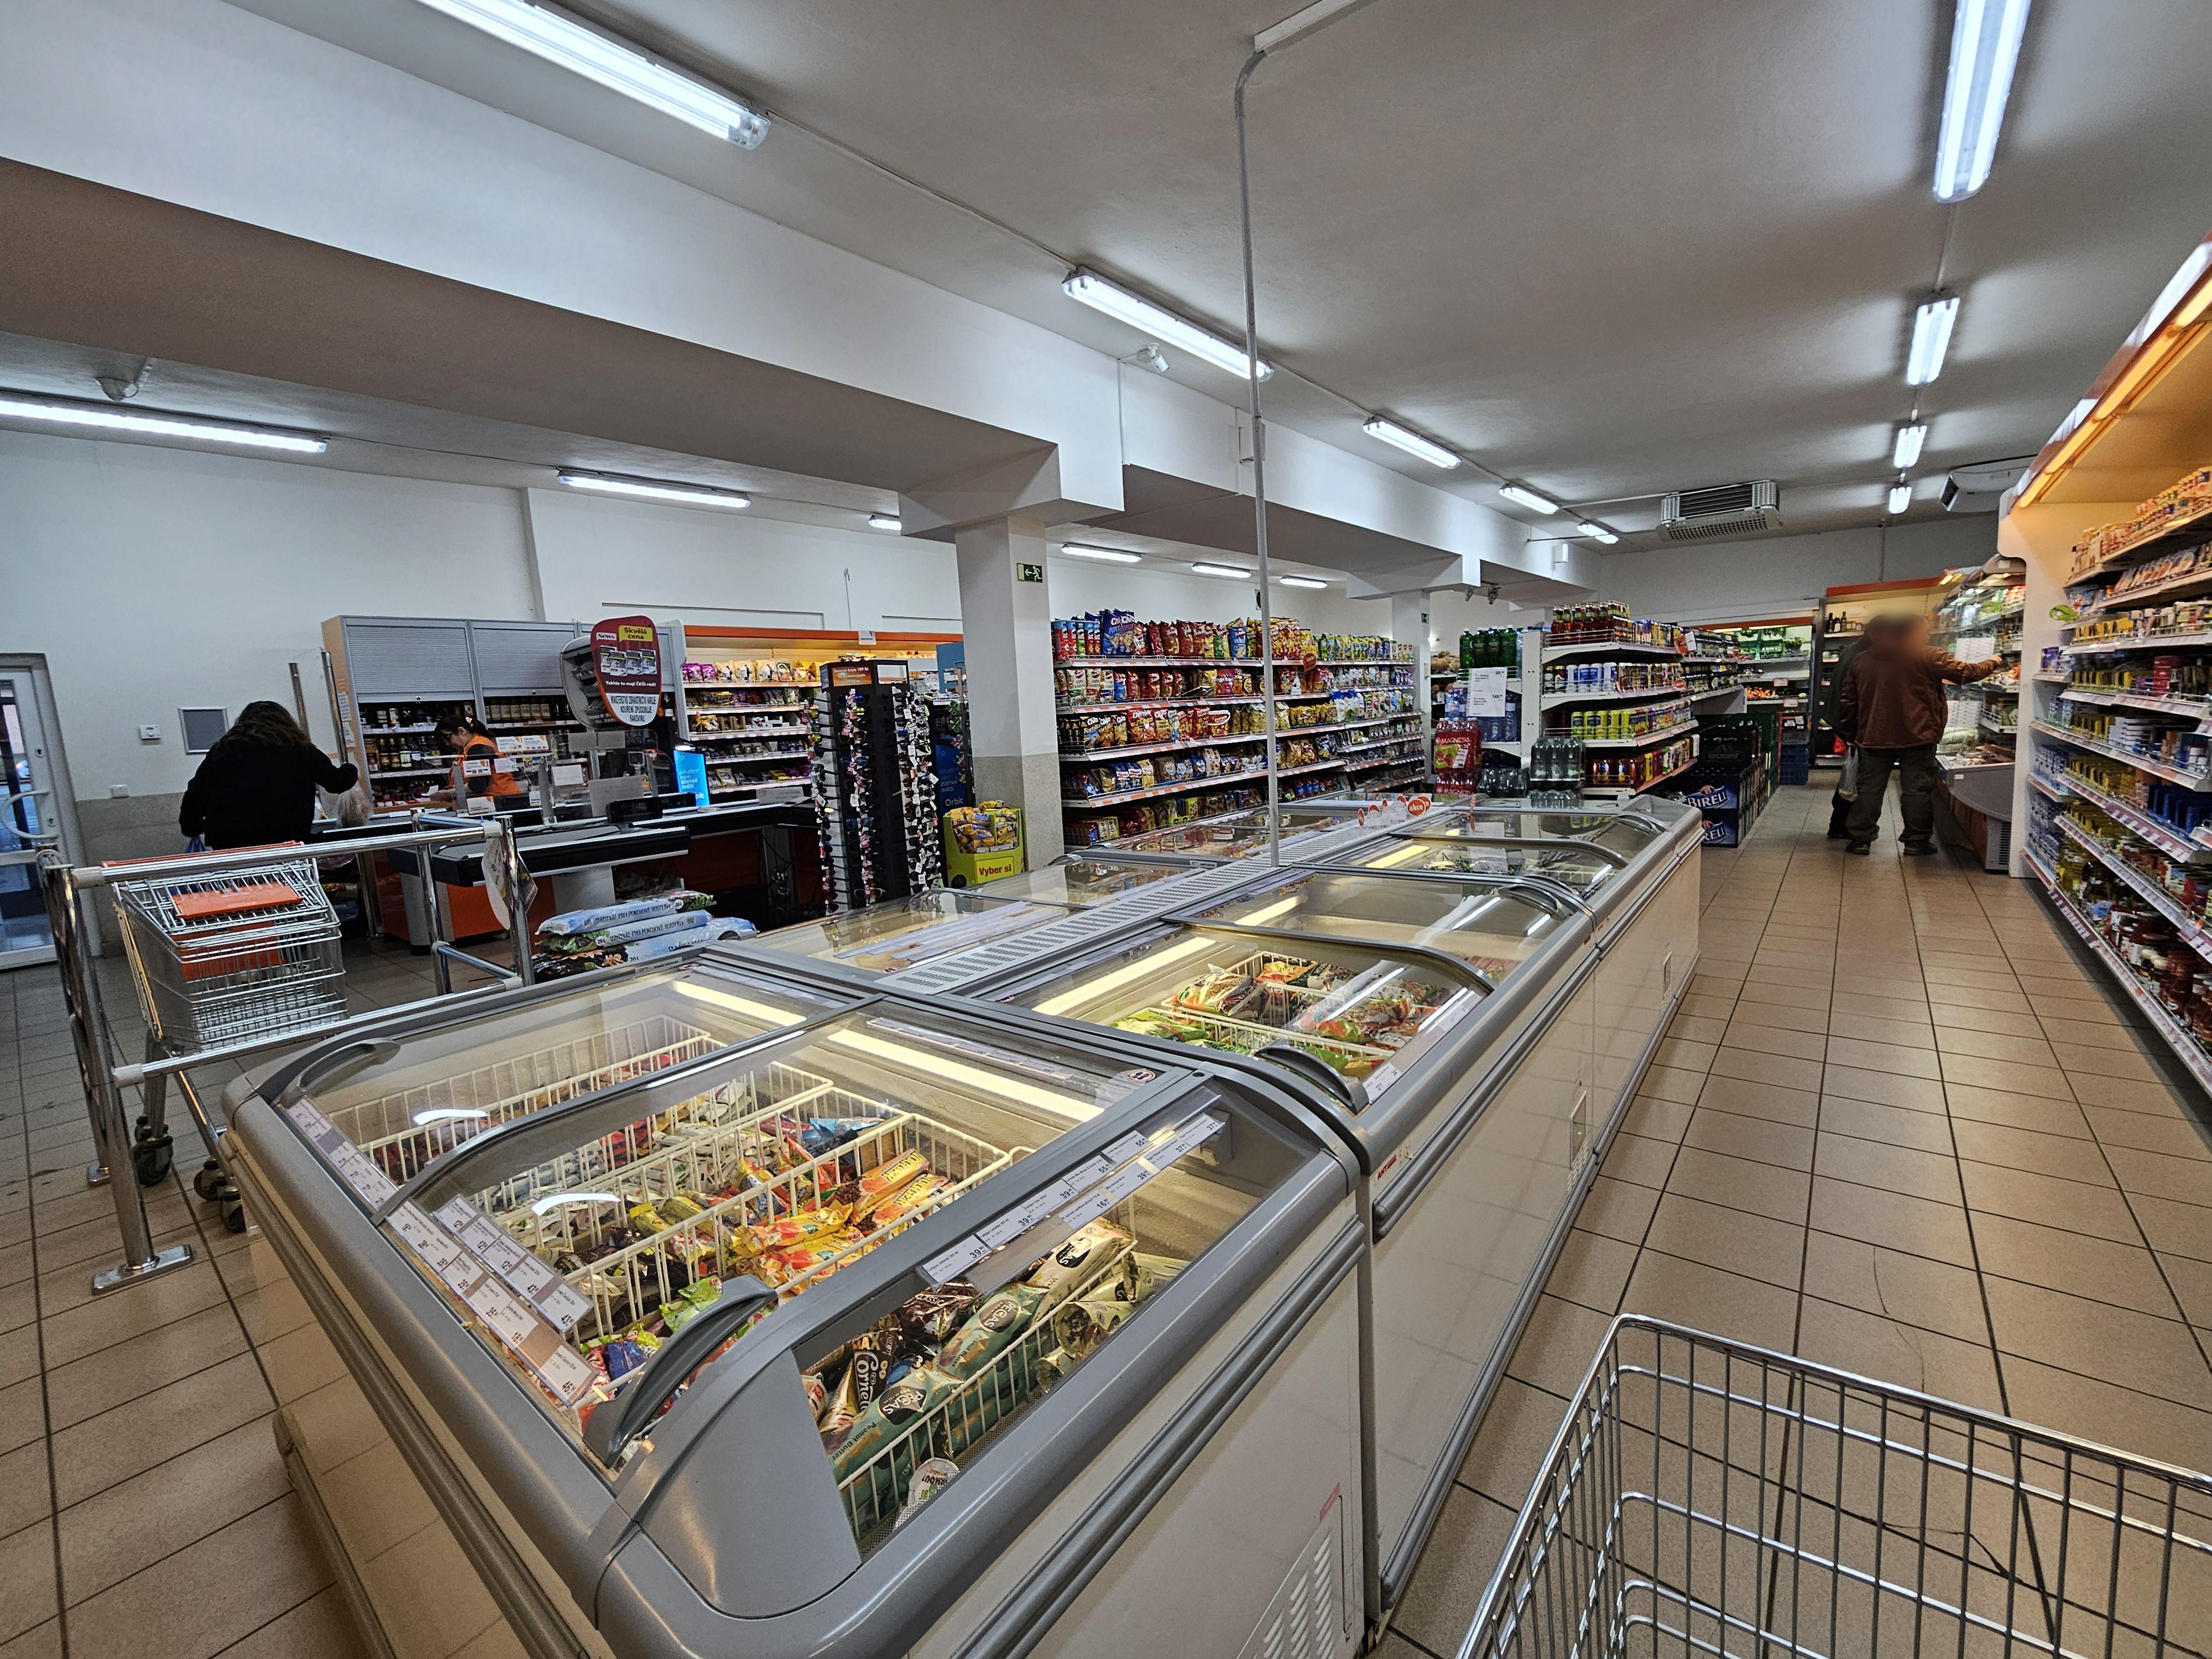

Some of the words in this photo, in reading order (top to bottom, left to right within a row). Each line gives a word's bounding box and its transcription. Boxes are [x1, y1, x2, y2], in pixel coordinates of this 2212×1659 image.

[945, 797, 963, 806] Orbit
[1688, 791, 1726, 807] BIRELL
[1409, 804, 1423, 812] akce
[1704, 826, 1725, 841] RELL
[979, 867, 1002, 876] Vyber
[1004, 864, 1011, 872] si
[1060, 1191, 1070, 1199] 39
[1019, 1217, 1029, 1226] 39
[969, 1249, 981, 1259] 39
[501, 1260, 510, 1269] 12
[526, 1284, 536, 1293] 43
[486, 1307, 496, 1317] 35
[984, 1301, 1017, 1327] PEGAS
[561, 1314, 571, 1324] 43
[511, 1332, 521, 1342] 18
[562, 1381, 573, 1392] 46
[883, 1391, 924, 1415] PEGAS
[854, 1422, 877, 1443] Peanut
[832, 1441, 853, 1460] Butter
